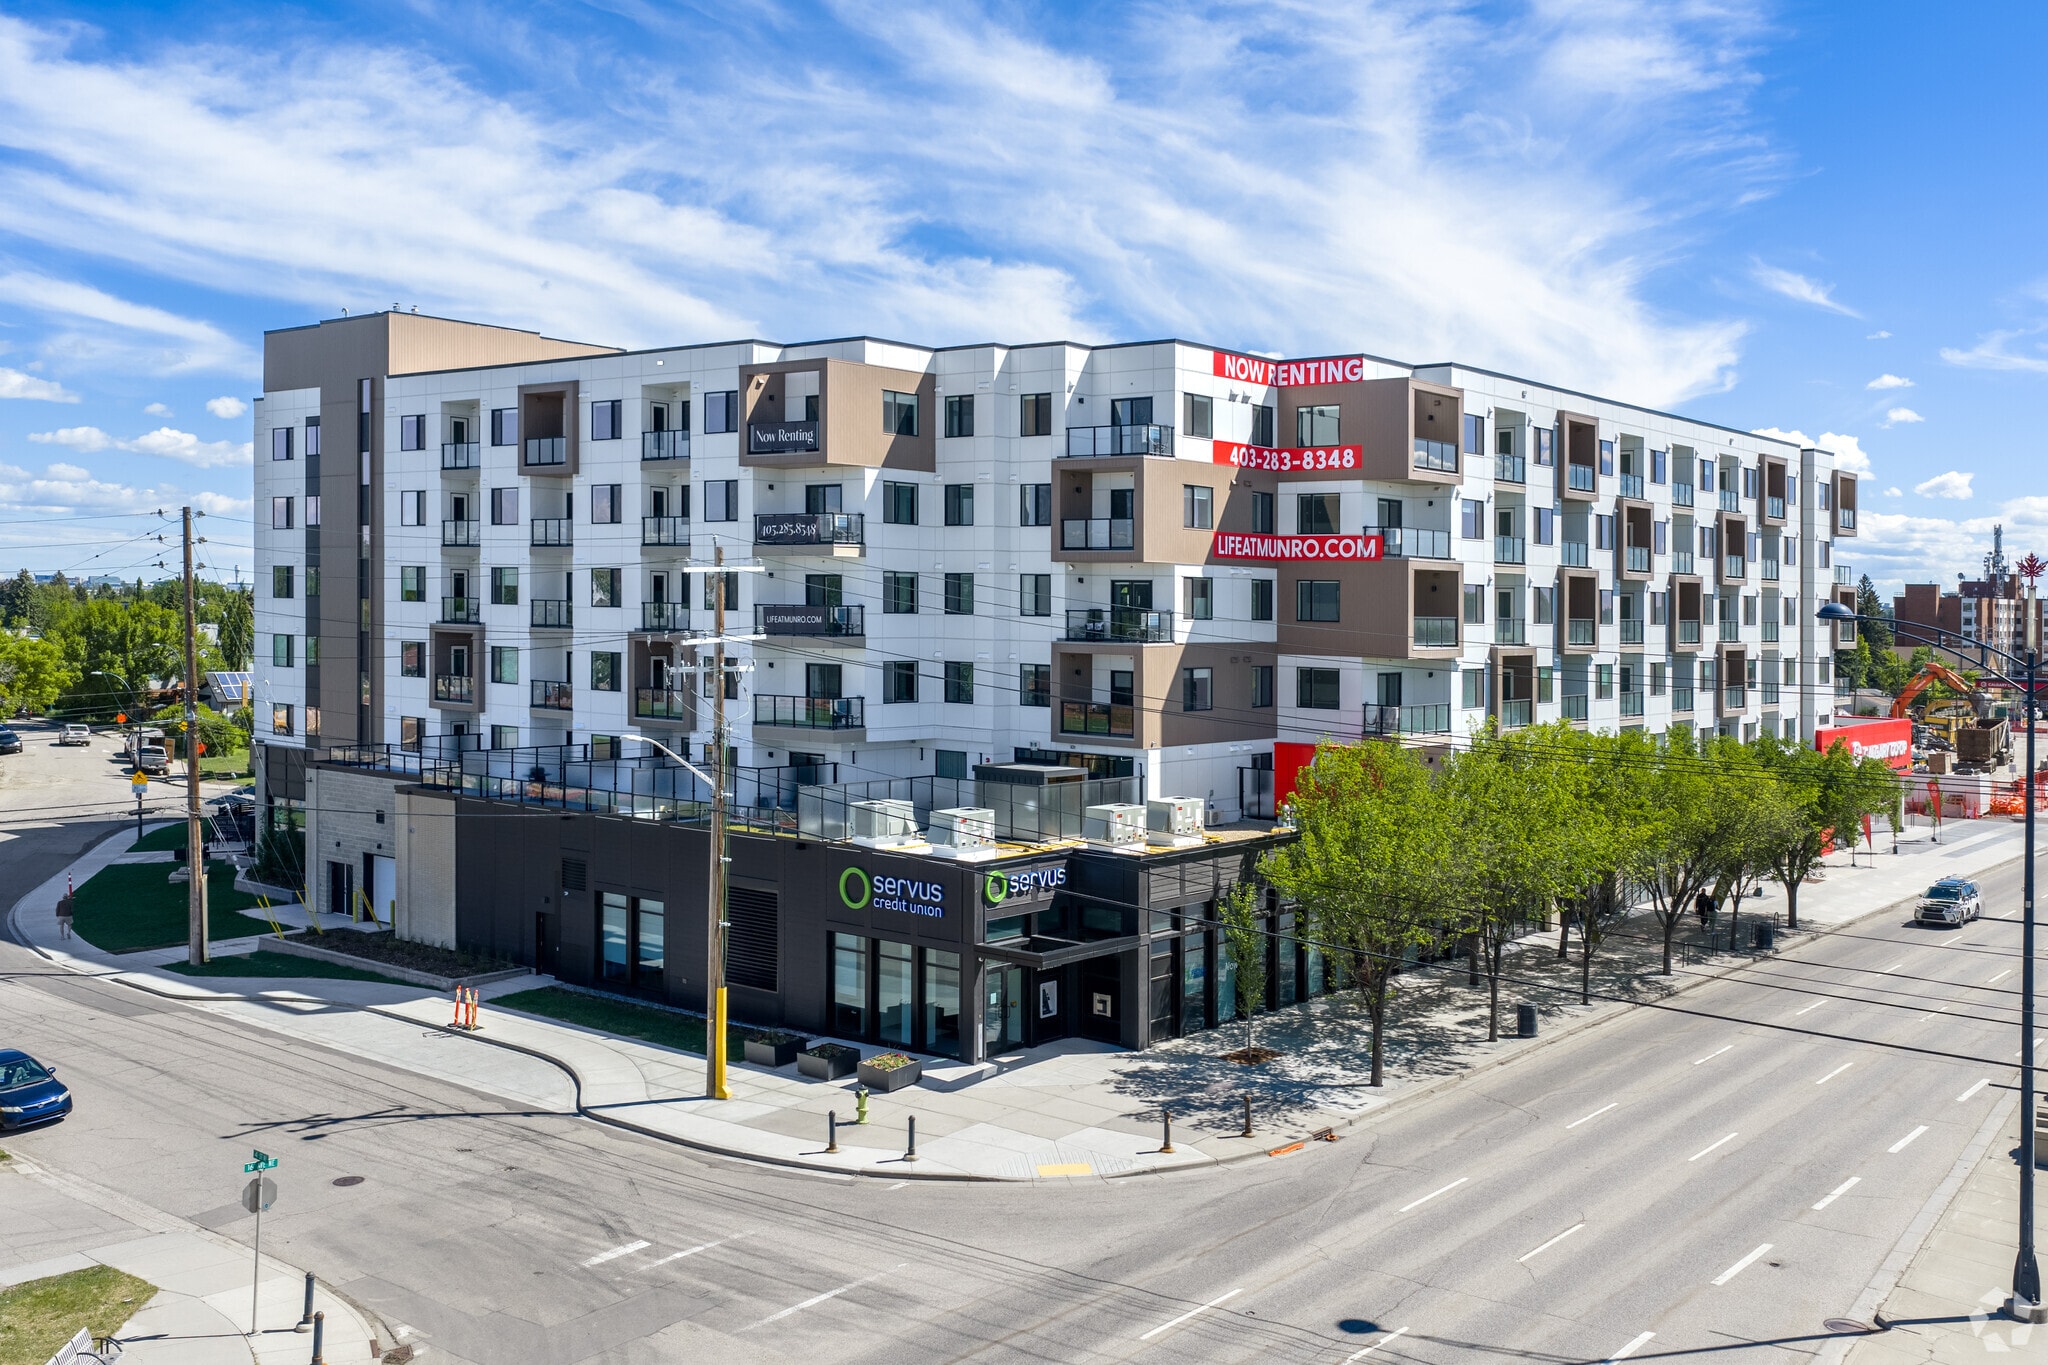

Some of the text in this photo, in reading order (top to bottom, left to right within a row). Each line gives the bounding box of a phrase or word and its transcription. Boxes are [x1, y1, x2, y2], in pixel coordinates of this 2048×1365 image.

[1225, 354, 1363, 386] NOW RENTING
[756, 429, 814, 444] Now Renting
[1230, 446, 1355, 471] 403-283-8348
[1218, 535, 1376, 558] LIFEATMUNRO.COM
[766, 615, 822, 624] LIFEATMUNRO.COM
[873, 875, 943, 902] servus
[1009, 867, 1066, 893] servus
[873, 897, 943, 918] credit union
